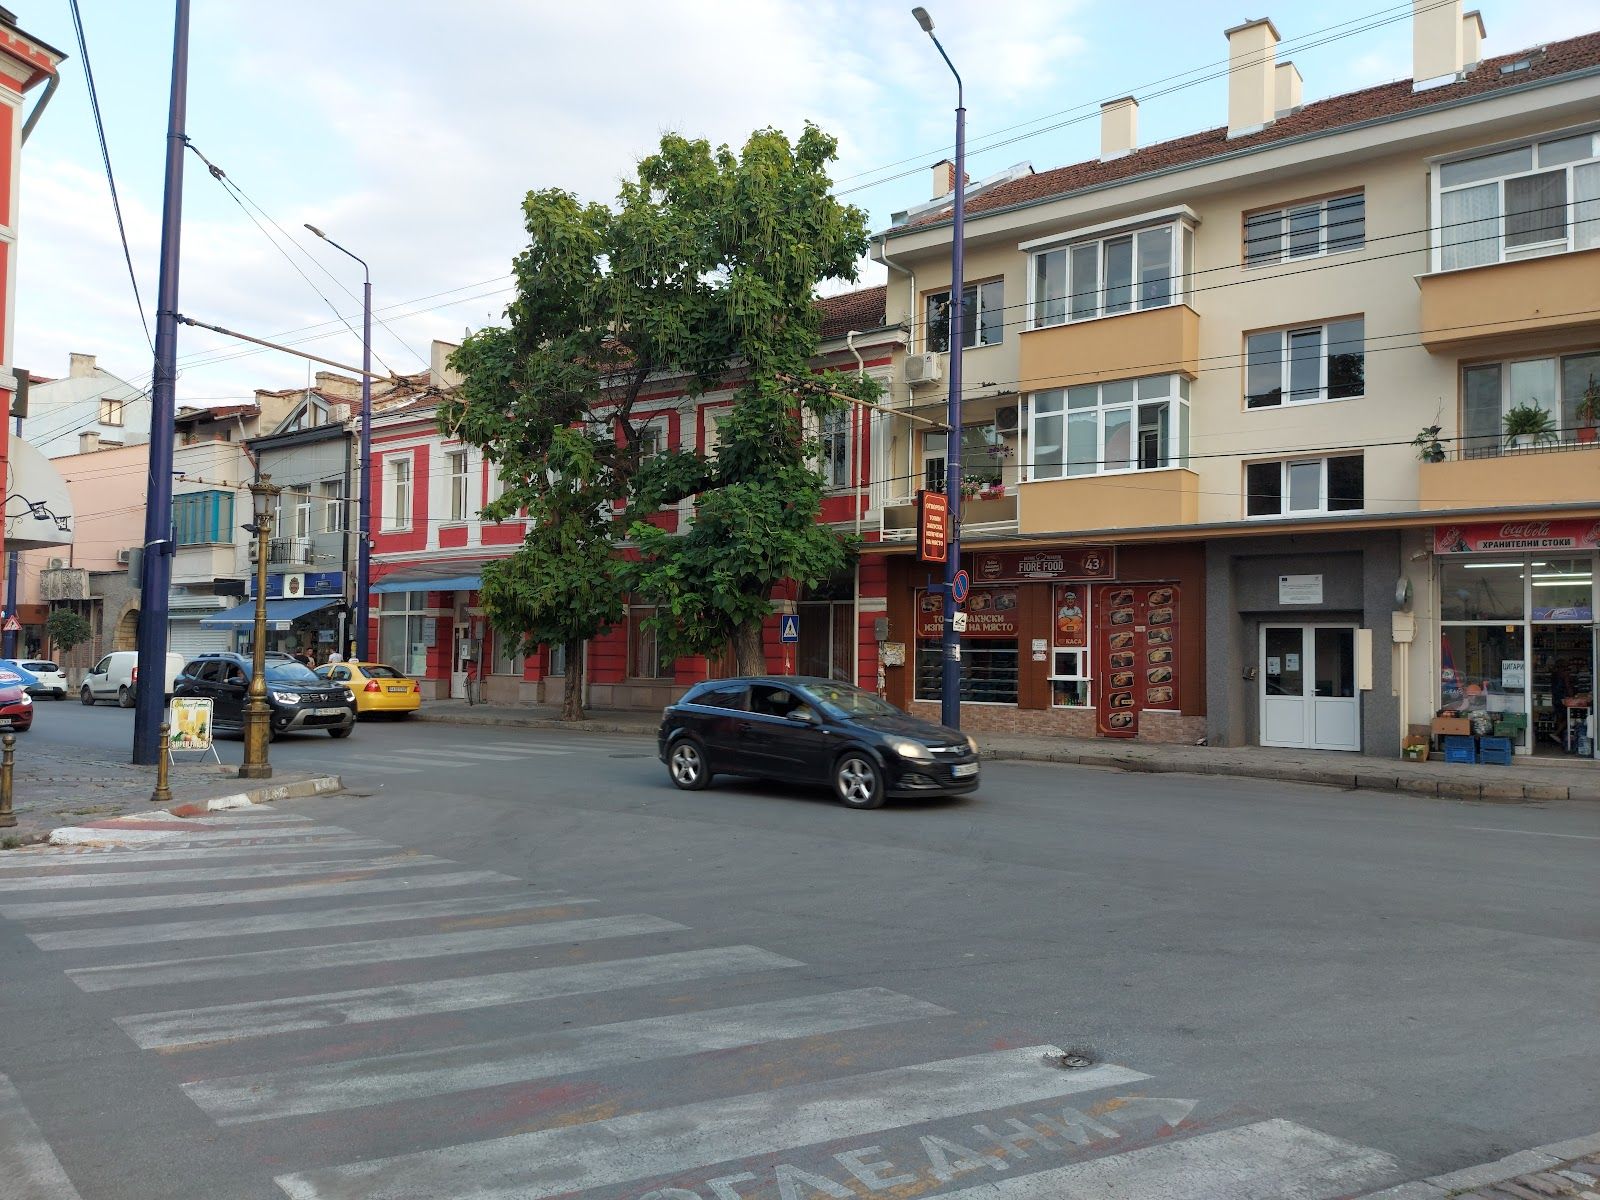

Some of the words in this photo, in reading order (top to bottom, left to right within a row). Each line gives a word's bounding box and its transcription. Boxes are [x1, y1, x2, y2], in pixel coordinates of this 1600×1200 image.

[1482, 540, 1539, 549] ХРАНИТЕЛНИ
[1542, 538, 1571, 547] СТОКИ
[1018, 561, 1041, 572] FIORE
[1043, 560, 1064, 571] FOOD
[1085, 558, 1100, 570] 43
[968, 623, 981, 632] НА
[982, 623, 1014, 632] МЯСТО
